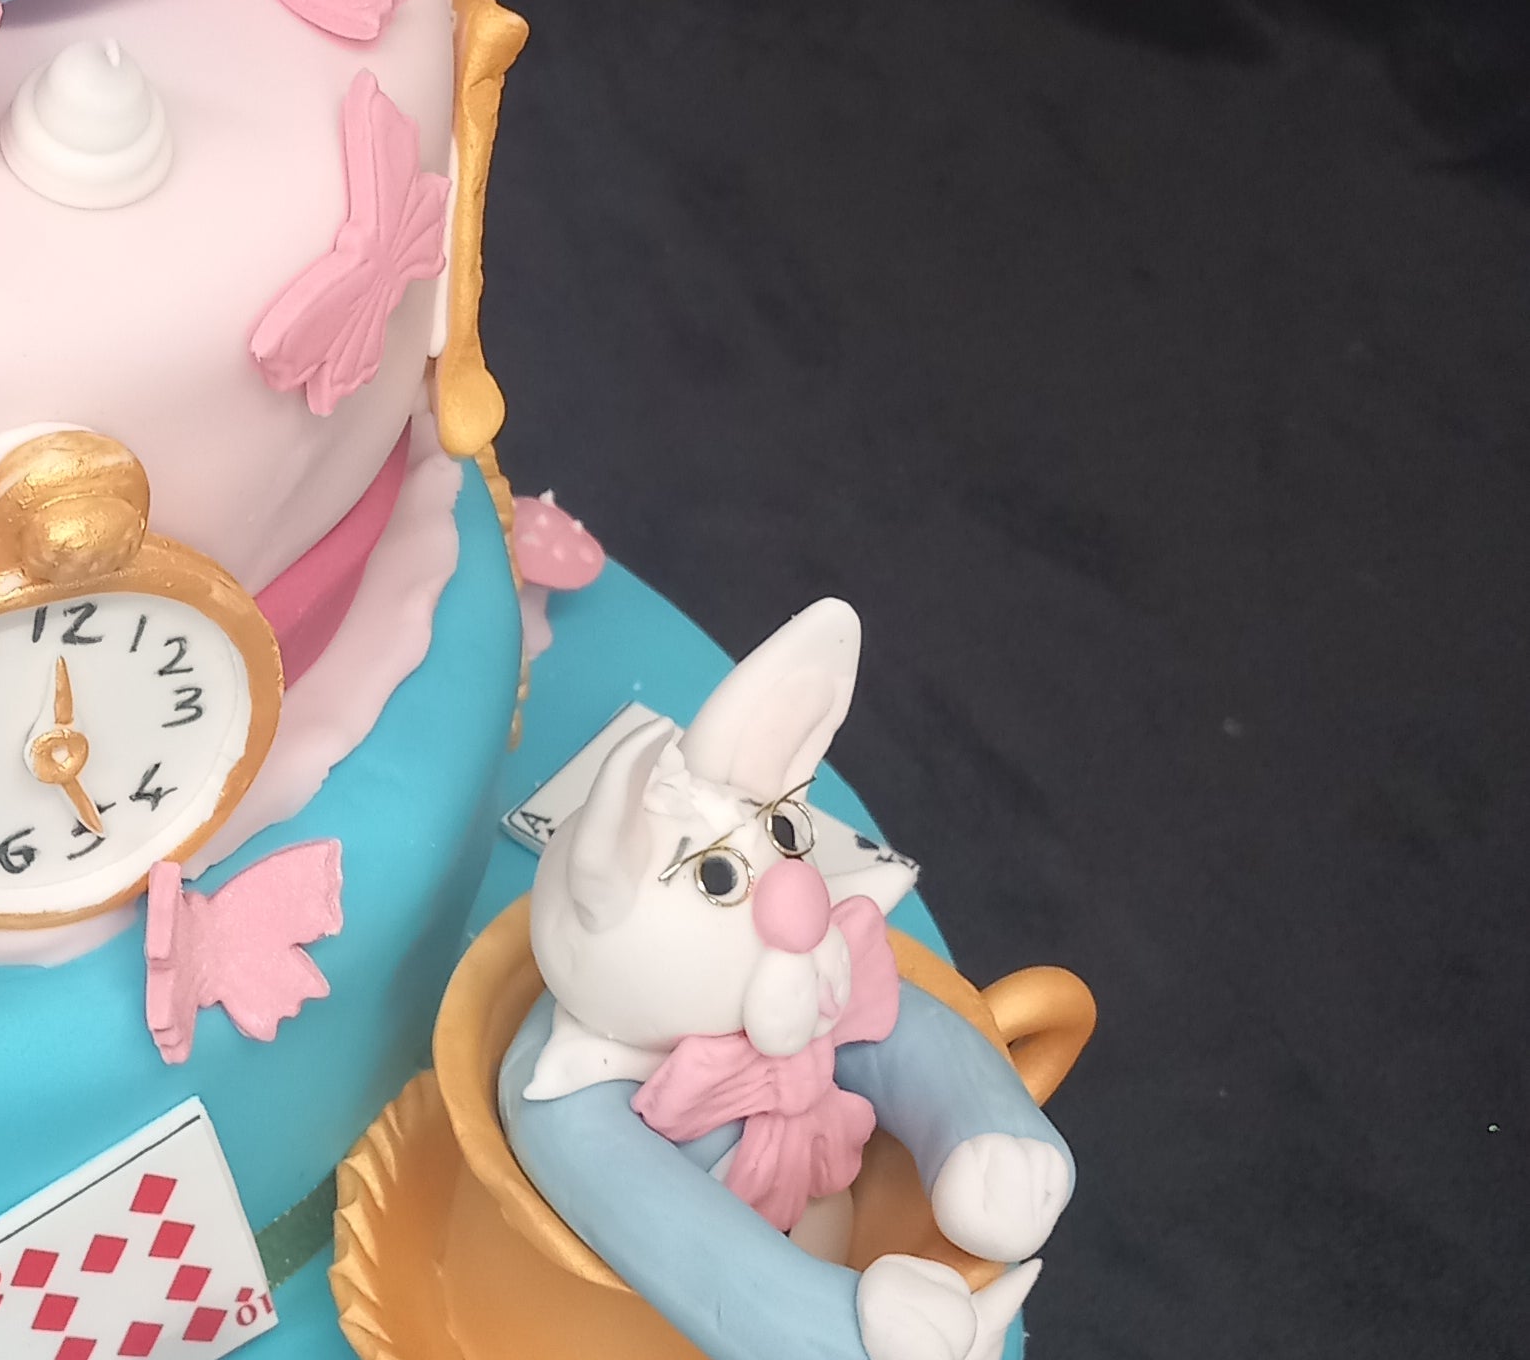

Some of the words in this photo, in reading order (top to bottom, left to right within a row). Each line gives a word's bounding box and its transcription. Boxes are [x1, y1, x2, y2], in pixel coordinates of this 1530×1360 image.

[32, 602, 103, 644] 12
[129, 614, 147, 653] 1
[156, 637, 194, 676] 2
[161, 687, 203, 729] 3
[128, 762, 178, 811] 4
[519, 810, 552, 834] A
[235, 1293, 273, 1327] 10
